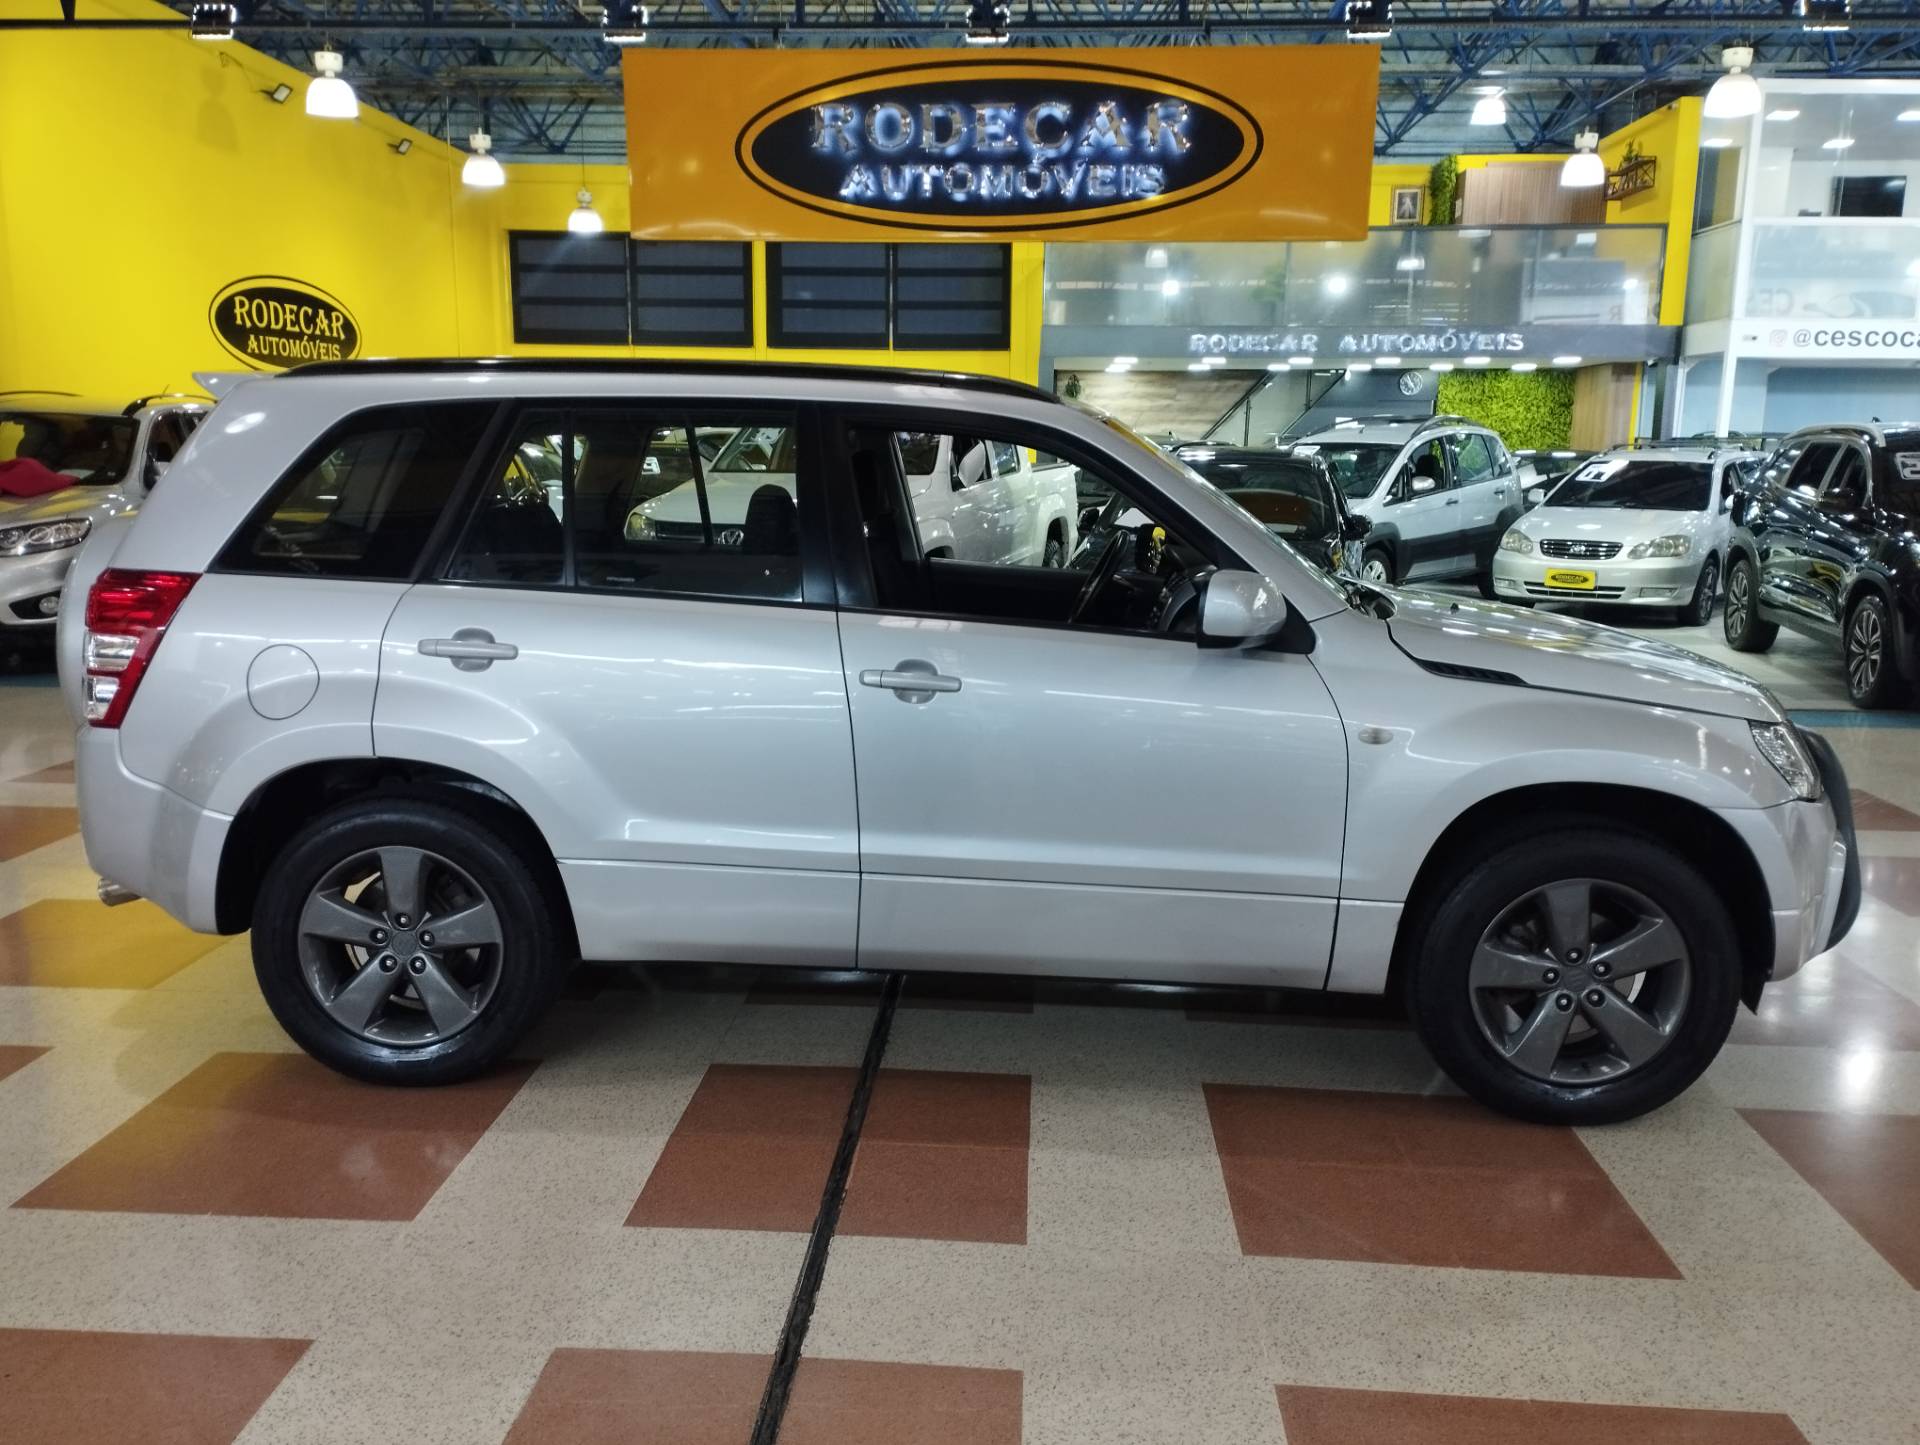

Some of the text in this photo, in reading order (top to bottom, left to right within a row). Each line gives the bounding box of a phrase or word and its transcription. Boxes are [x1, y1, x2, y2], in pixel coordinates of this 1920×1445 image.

[809, 101, 1192, 151] RODECAR
[839, 155, 1166, 200] AUTOMÓVEIS
[234, 296, 346, 340] RODECAR
[1189, 328, 1526, 352] RODECAR AUTOMÓVEIS
[247, 334, 341, 360] AUTOMÓVEIS
